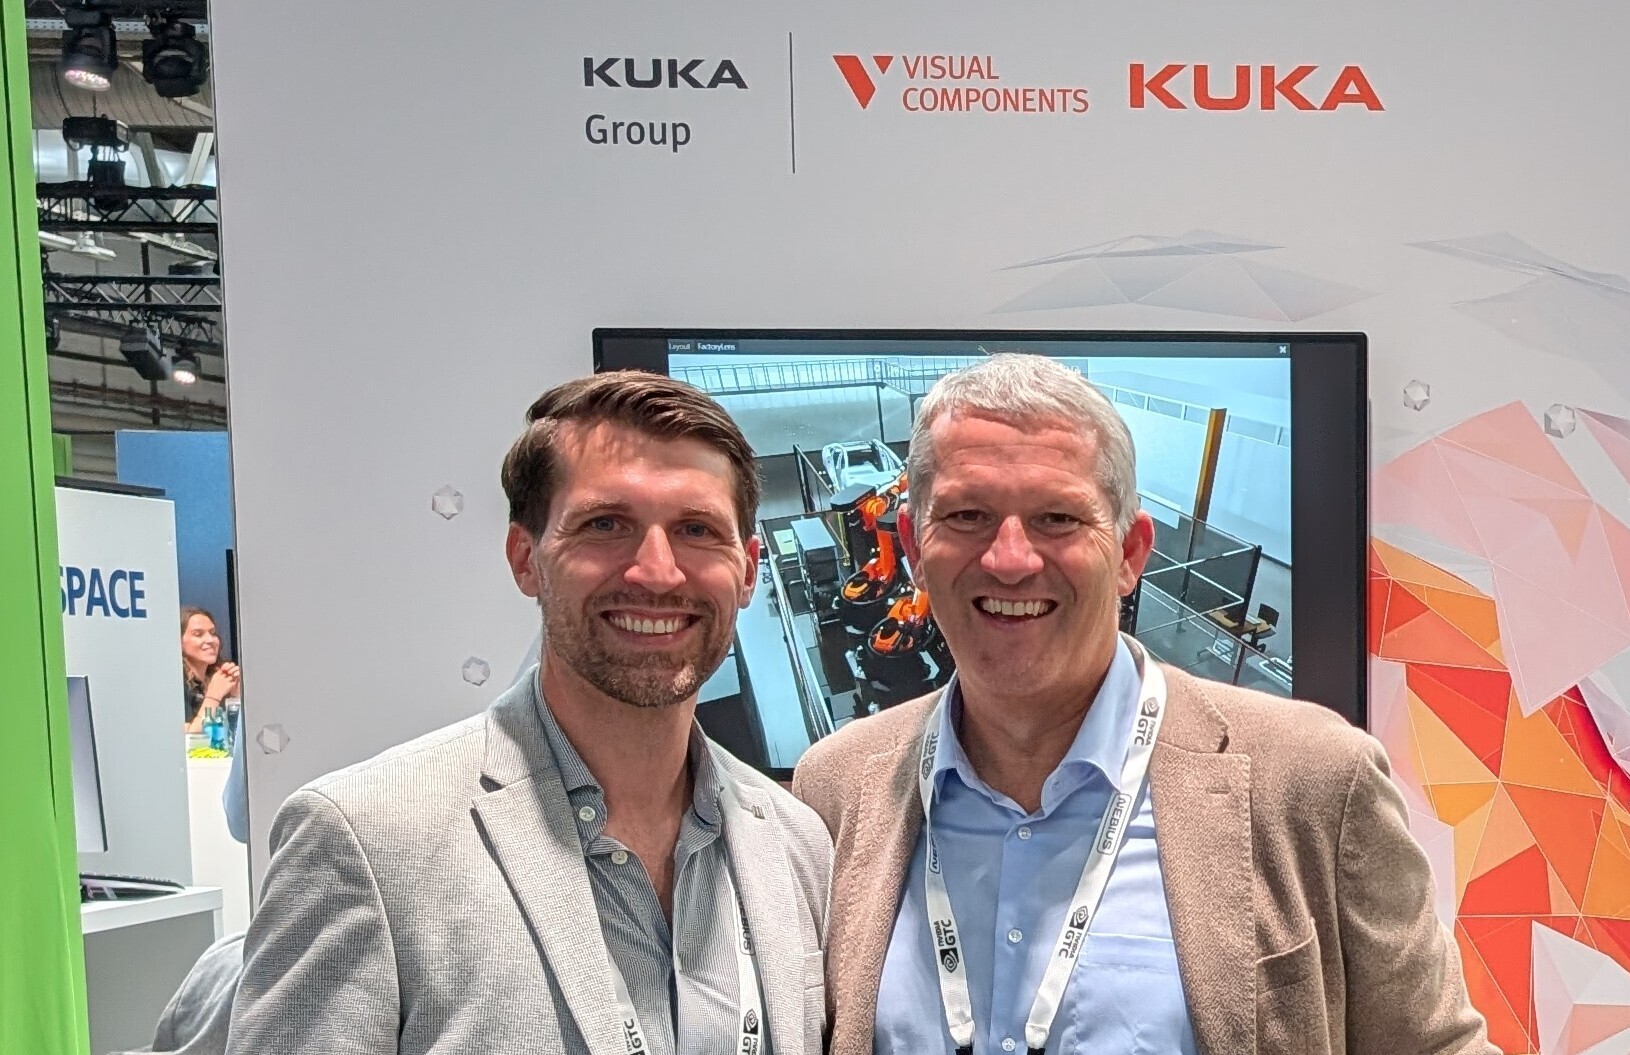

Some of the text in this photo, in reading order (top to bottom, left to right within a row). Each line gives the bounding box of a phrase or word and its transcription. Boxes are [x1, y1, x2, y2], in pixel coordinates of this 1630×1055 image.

[583, 57, 749, 89] KUKA
[901, 55, 1000, 80] VISUAL
[902, 87, 1089, 114] COMPONENTS
[1129, 63, 1386, 112] KUKA
[585, 114, 691, 153] Group
[1134, 718, 1149, 746] GTC
[1102, 797, 1127, 850] NEBIUS
[940, 919, 956, 946] GTC
[1059, 930, 1075, 958] GTC
[624, 1018, 642, 1048] GTC
